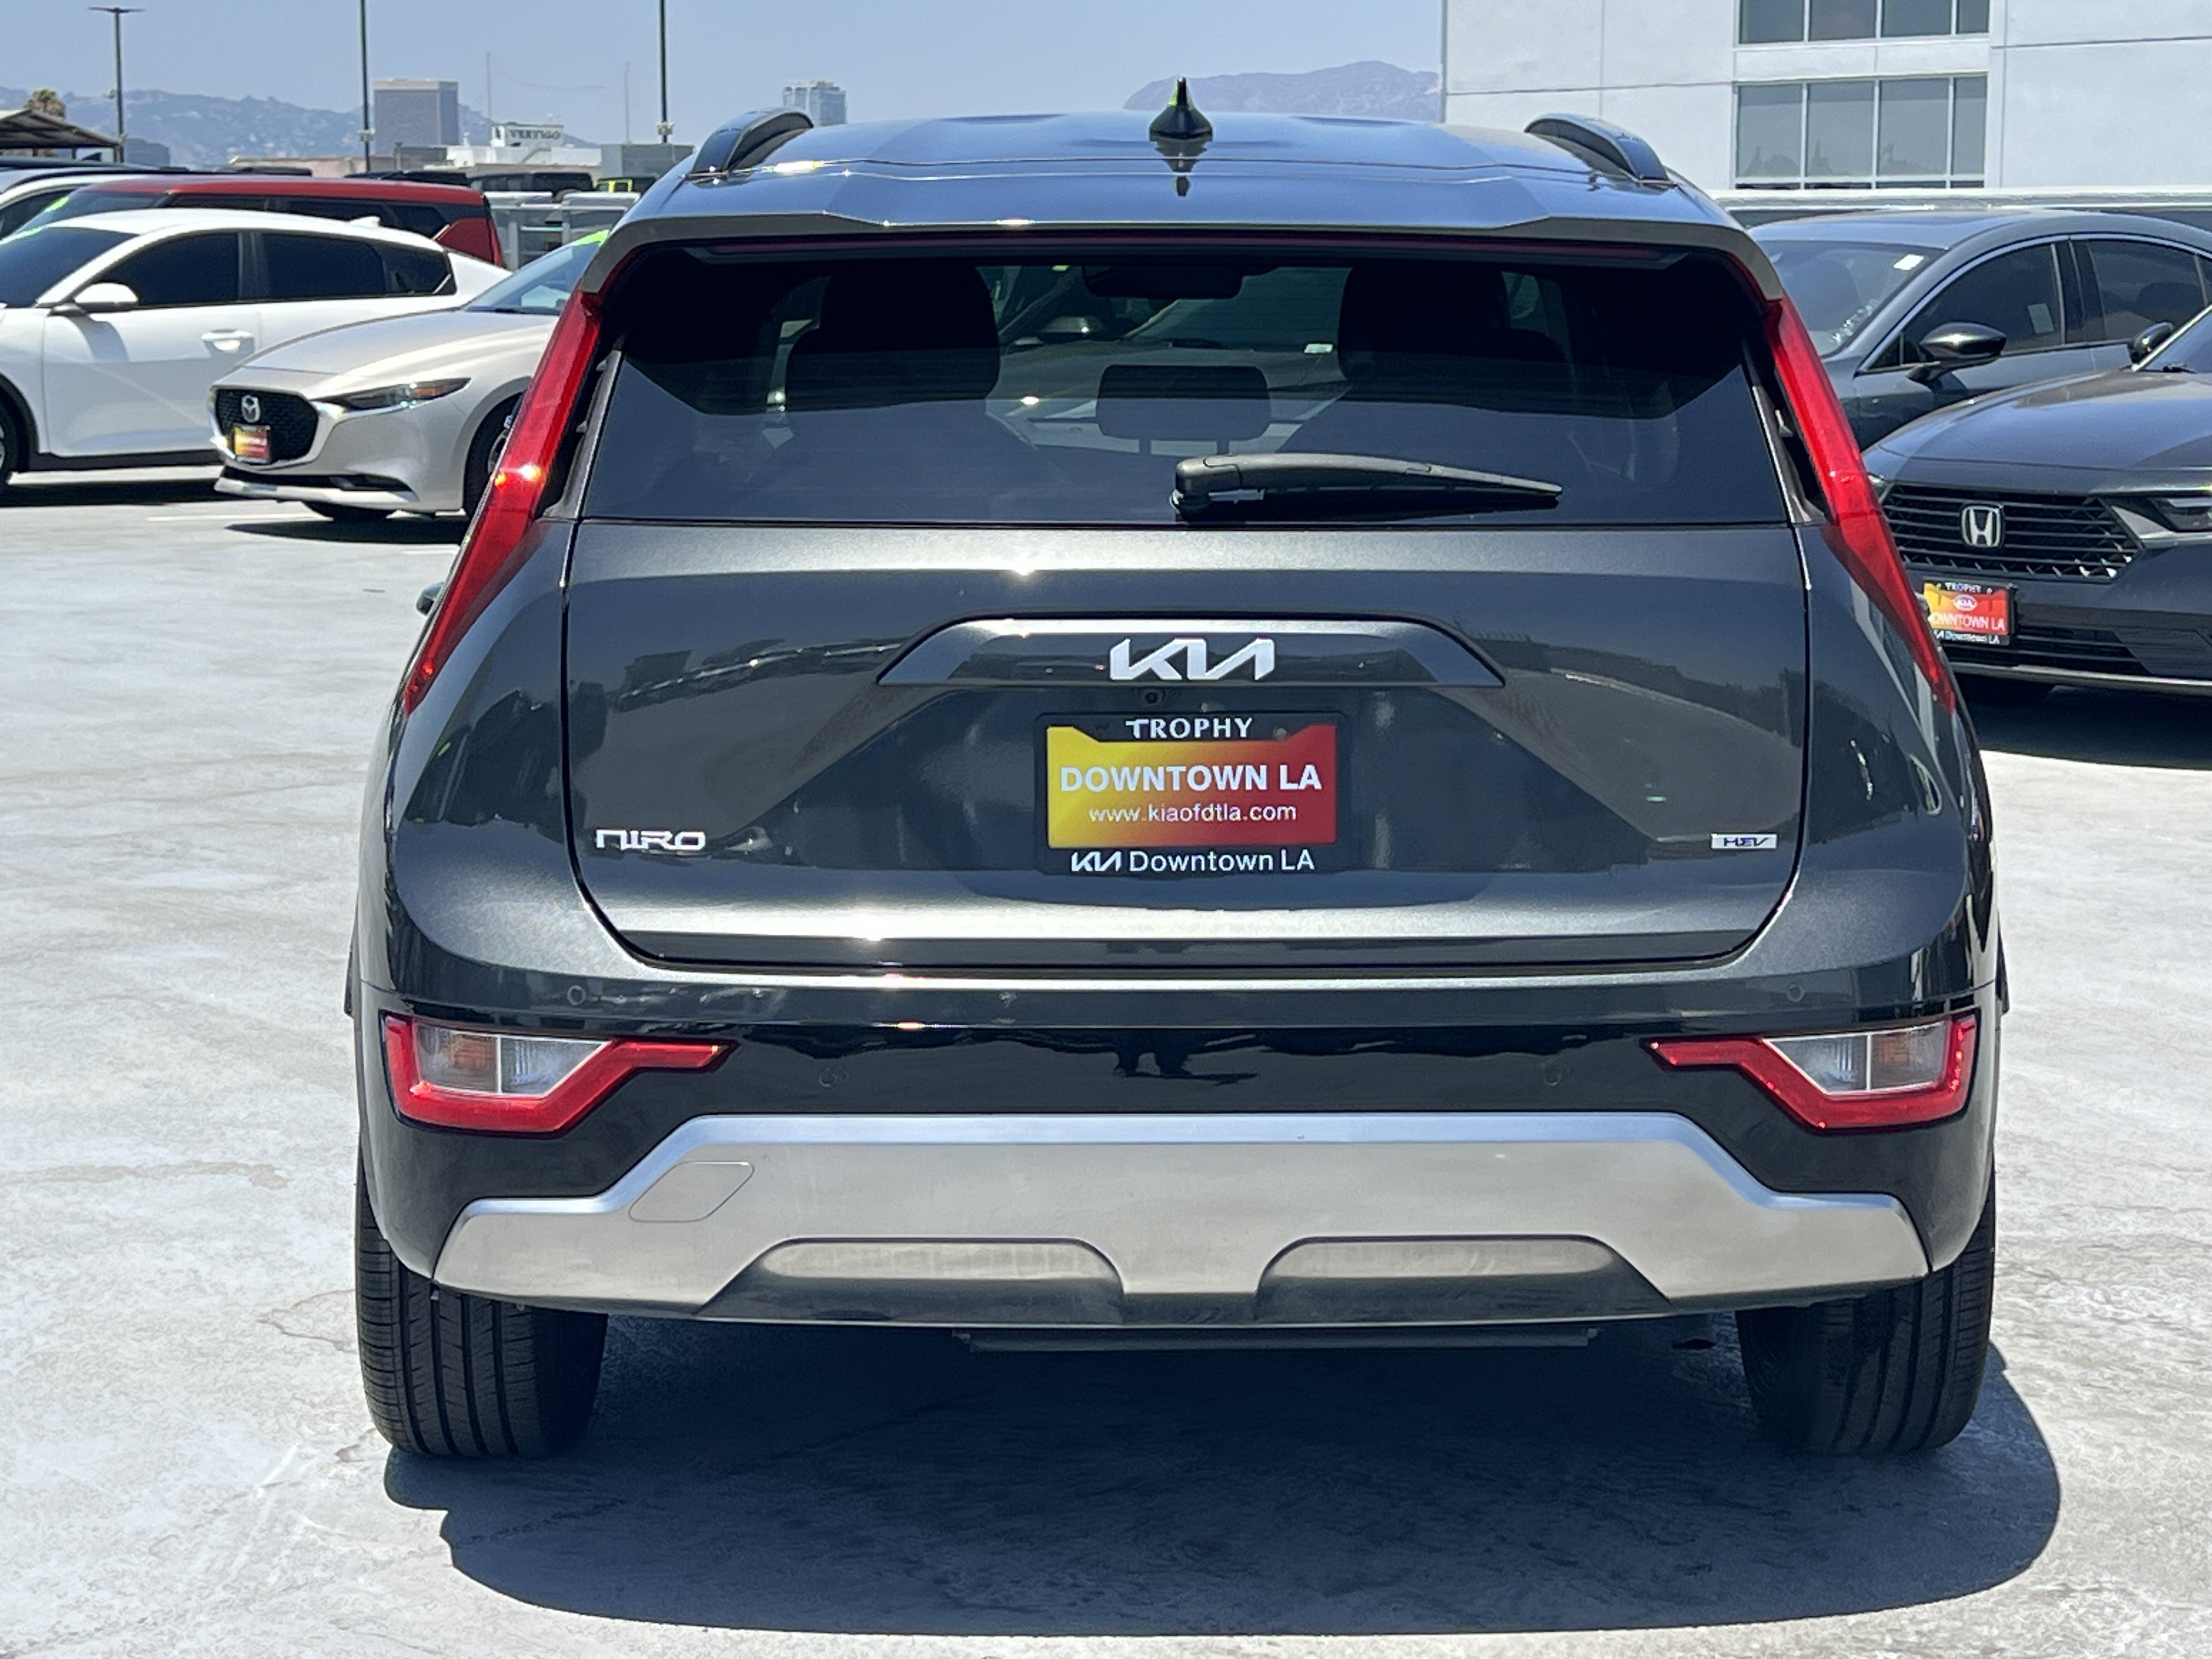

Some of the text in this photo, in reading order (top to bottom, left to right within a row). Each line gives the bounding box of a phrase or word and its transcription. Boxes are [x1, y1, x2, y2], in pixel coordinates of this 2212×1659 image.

[1991, 617, 2005, 631] LA
[1109, 637, 1276, 680] KIA
[1125, 718, 1253, 739] TROPHY
[1060, 764, 1322, 792] DOWNTOWN LA
[1088, 803, 1297, 822] www.kiaofdtla.com
[595, 828, 706, 851] NIRO
[1723, 836, 1769, 847] HEV
[1070, 849, 1316, 872] KIA Downtown LA
